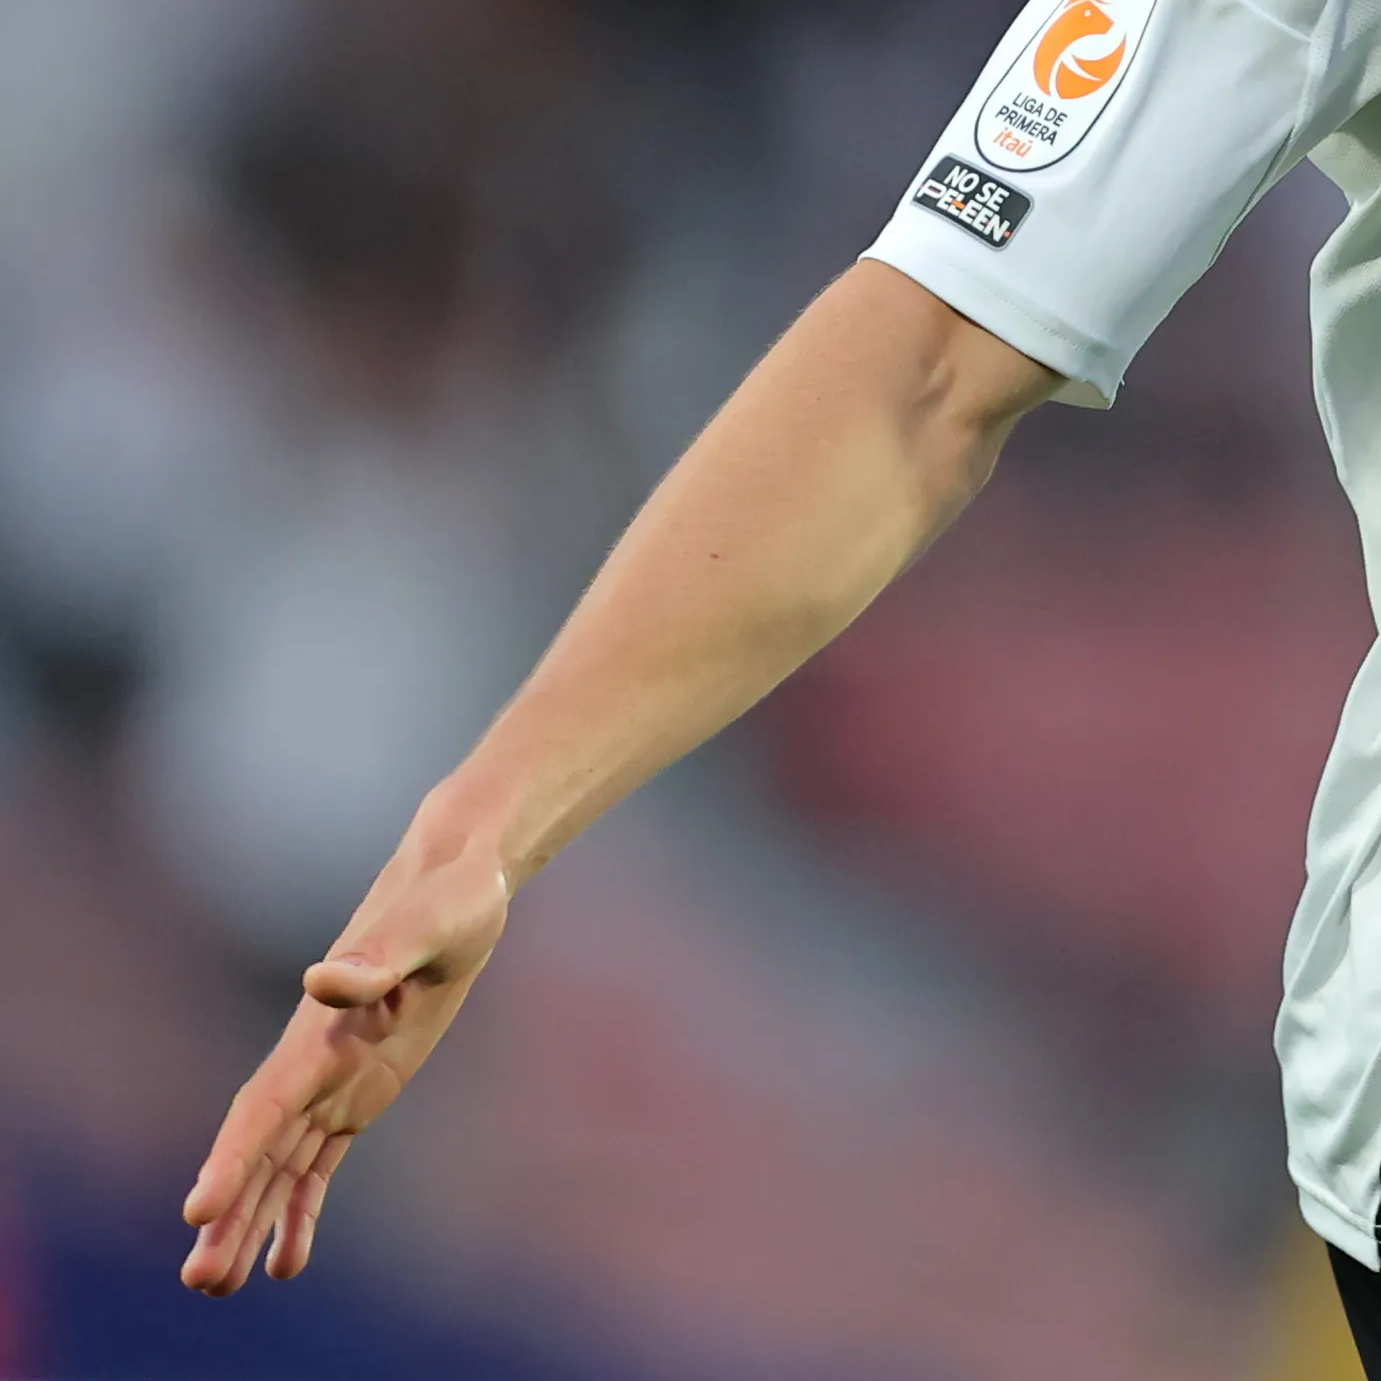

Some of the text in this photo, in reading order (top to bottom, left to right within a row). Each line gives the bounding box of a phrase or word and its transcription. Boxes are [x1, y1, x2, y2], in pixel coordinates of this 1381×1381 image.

[993, 104, 1058, 146] PRIMERA
[1011, 91, 1069, 128] LIGA DE
[992, 126, 1034, 158] itaú
[943, 164, 1011, 212] NO SE
